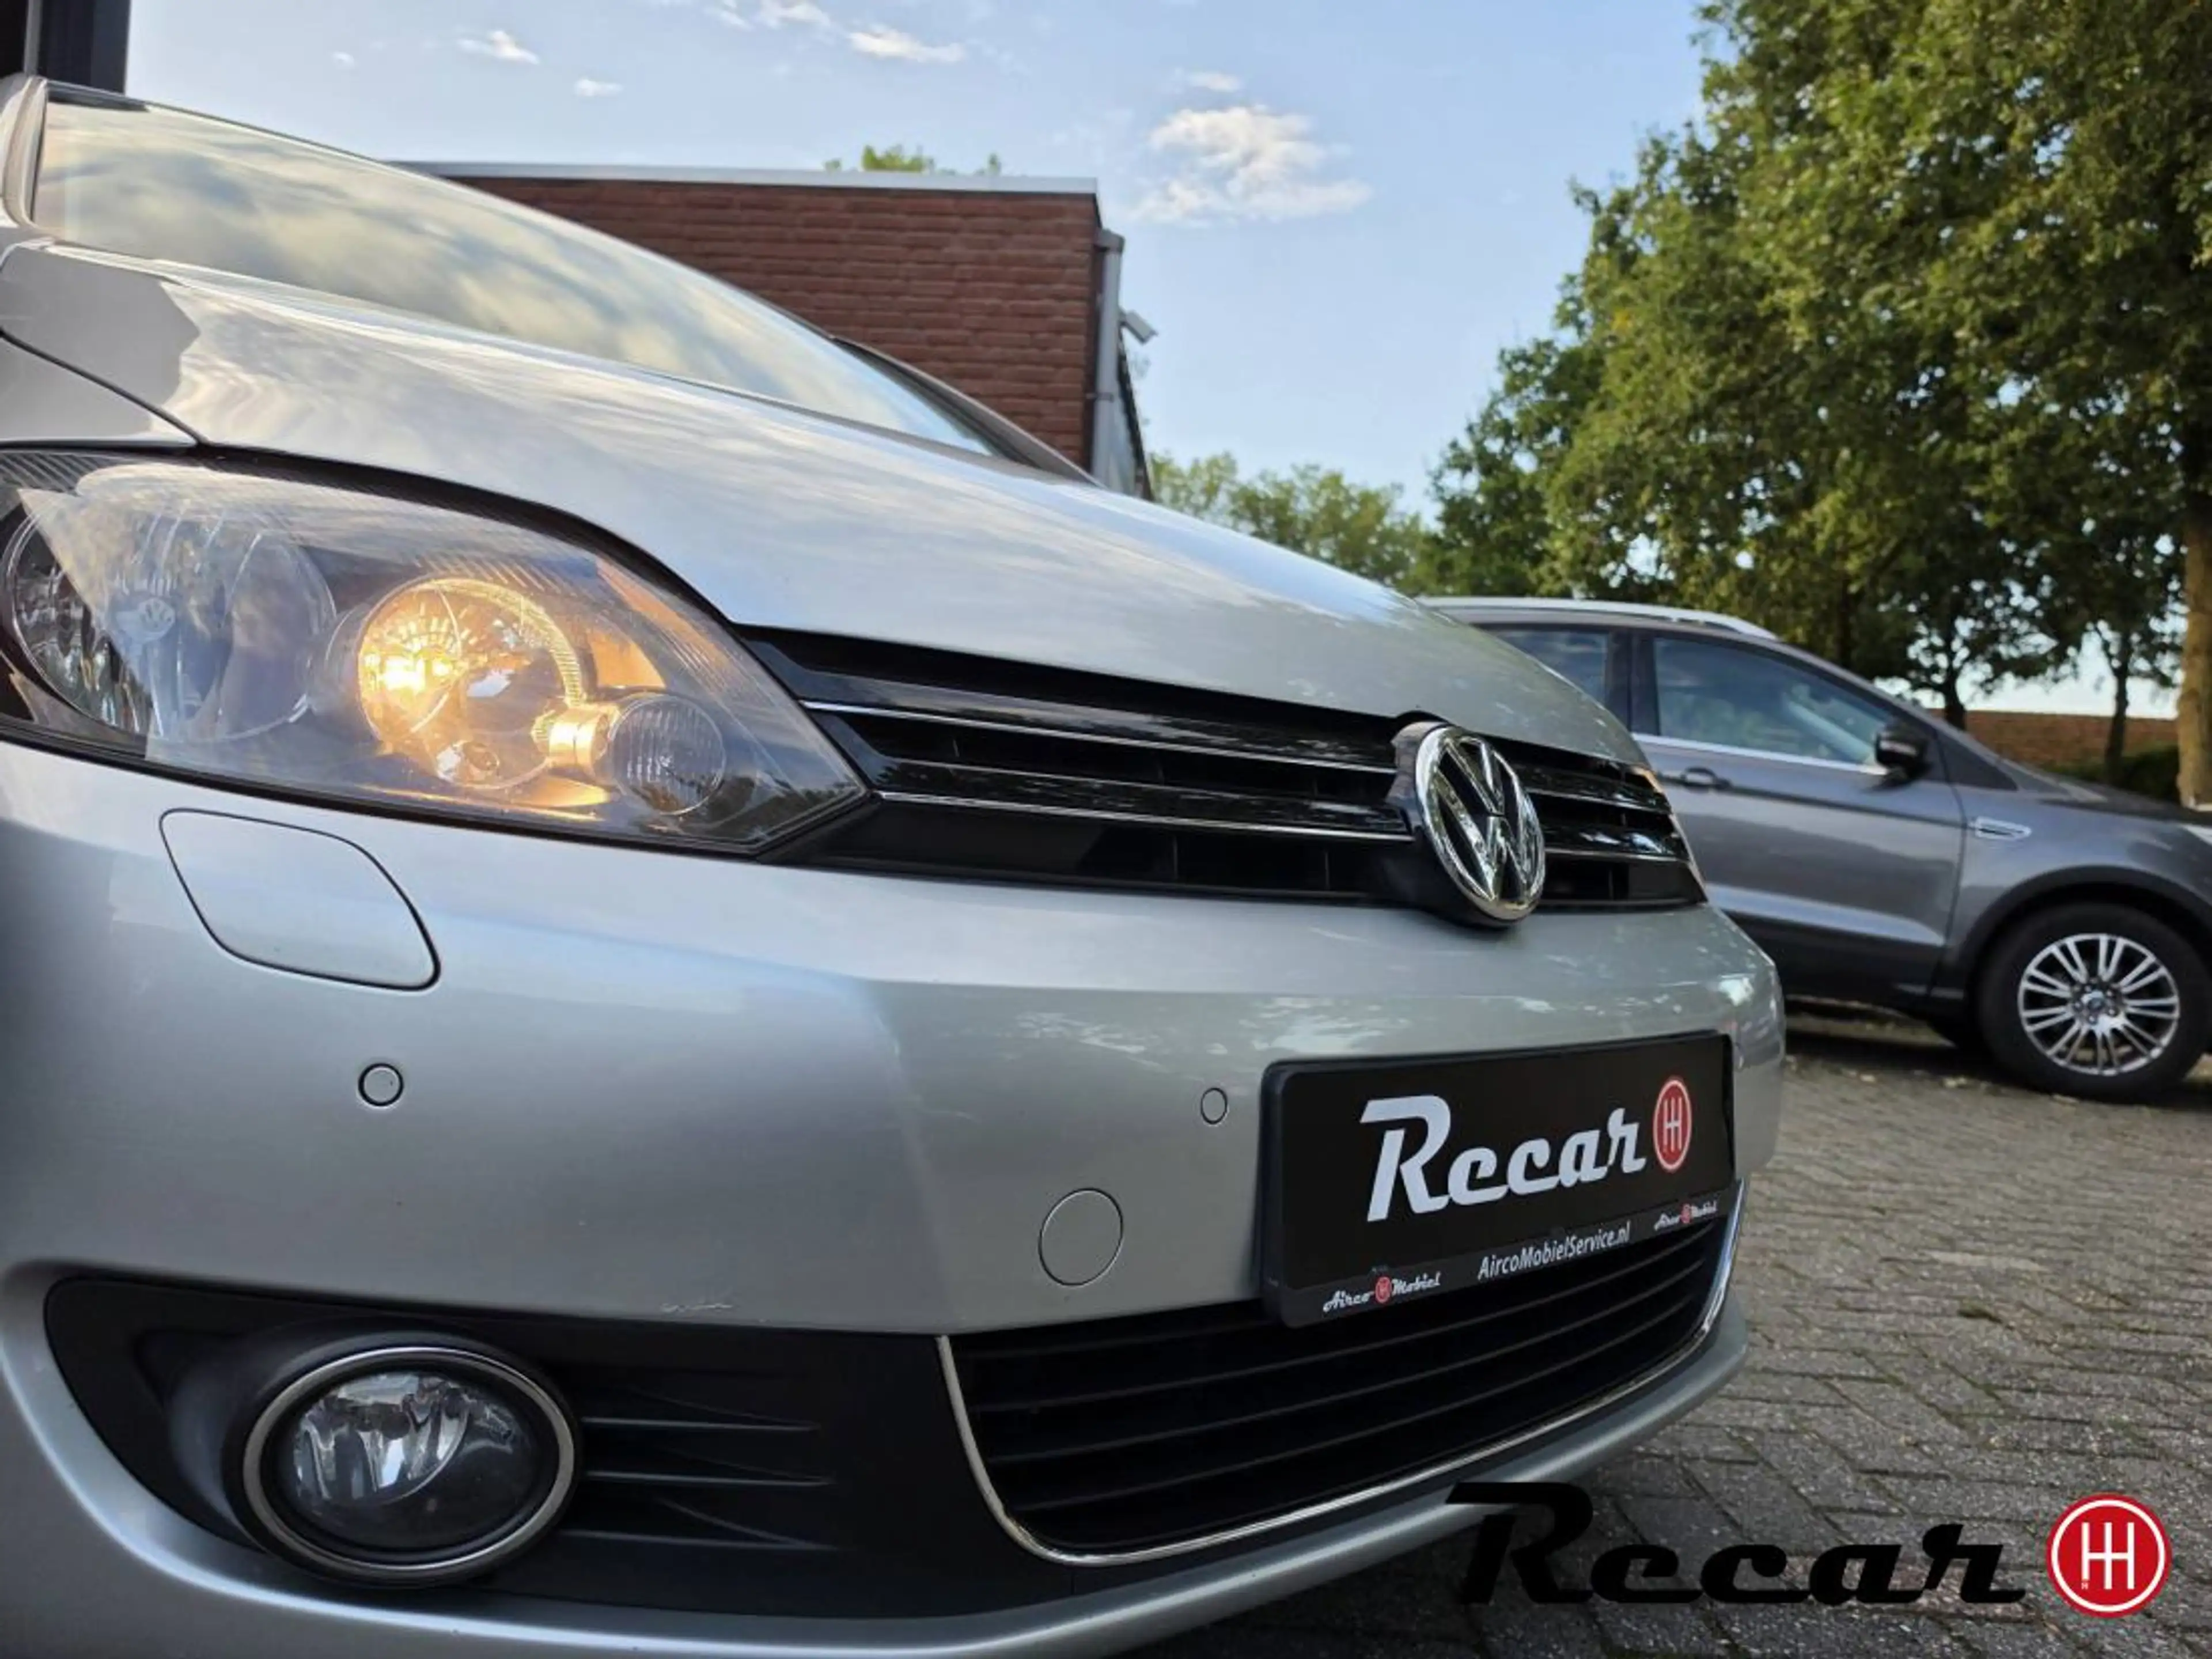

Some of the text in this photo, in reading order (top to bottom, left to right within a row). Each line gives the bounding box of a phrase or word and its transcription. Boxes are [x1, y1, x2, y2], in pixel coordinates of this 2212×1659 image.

[1360, 1094, 1646, 1222] Recar
[1477, 1219, 1631, 1281] AircoMobielService.nl
[1323, 1290, 1374, 1312] Airco
